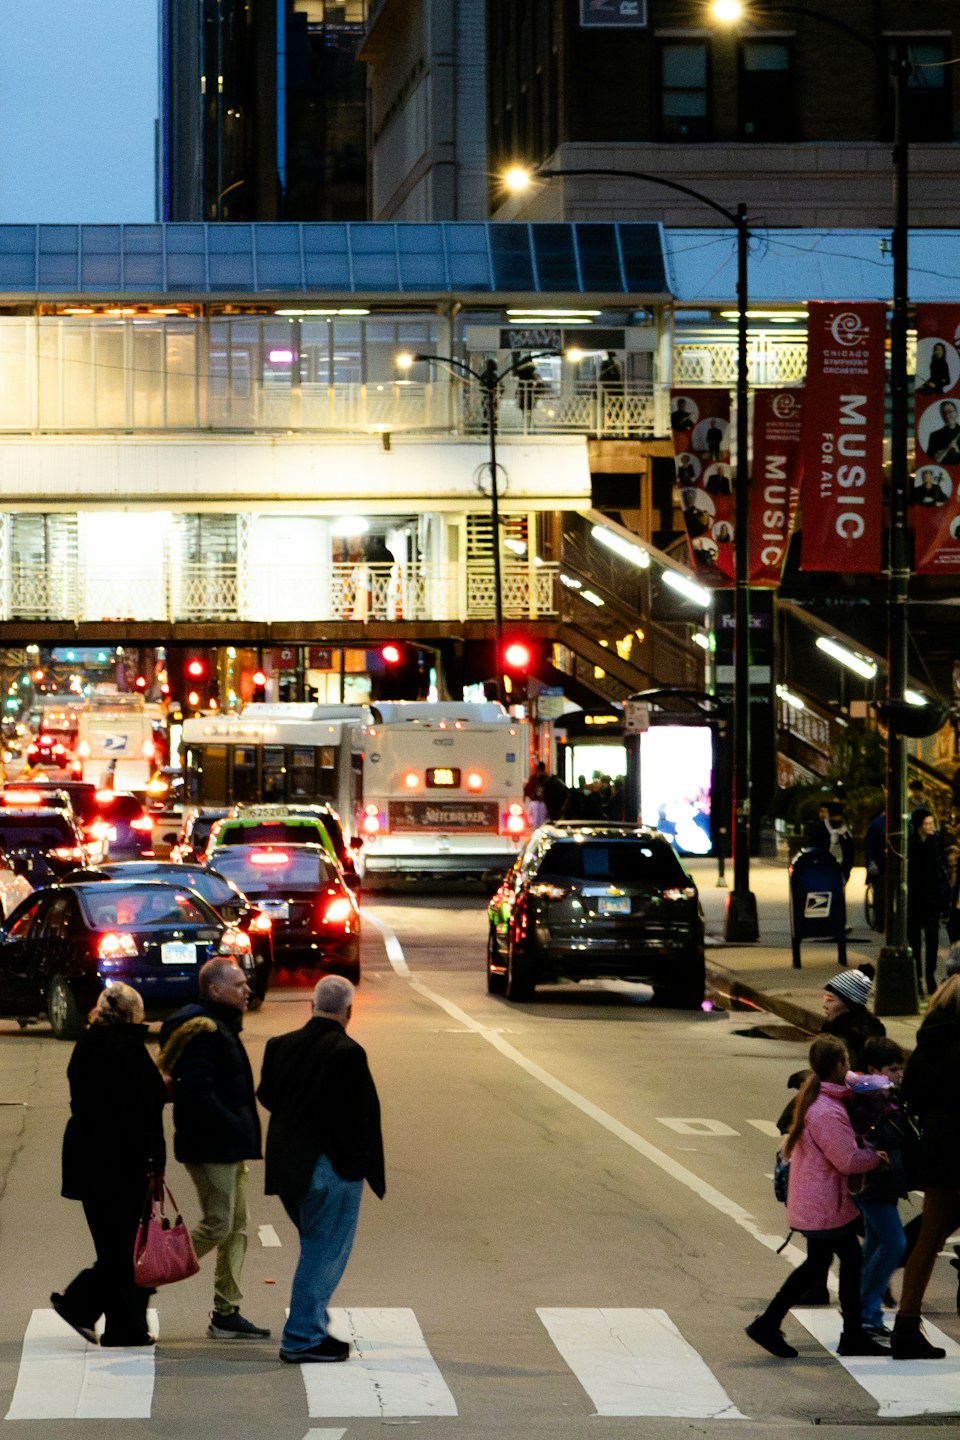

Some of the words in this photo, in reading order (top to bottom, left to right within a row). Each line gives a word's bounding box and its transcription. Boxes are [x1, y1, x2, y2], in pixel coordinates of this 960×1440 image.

[820, 470, 833, 498] ALL
[821, 433, 834, 464] FOR
[835, 394, 868, 540] MUSIC
[760, 455, 787, 566] MUSIC
